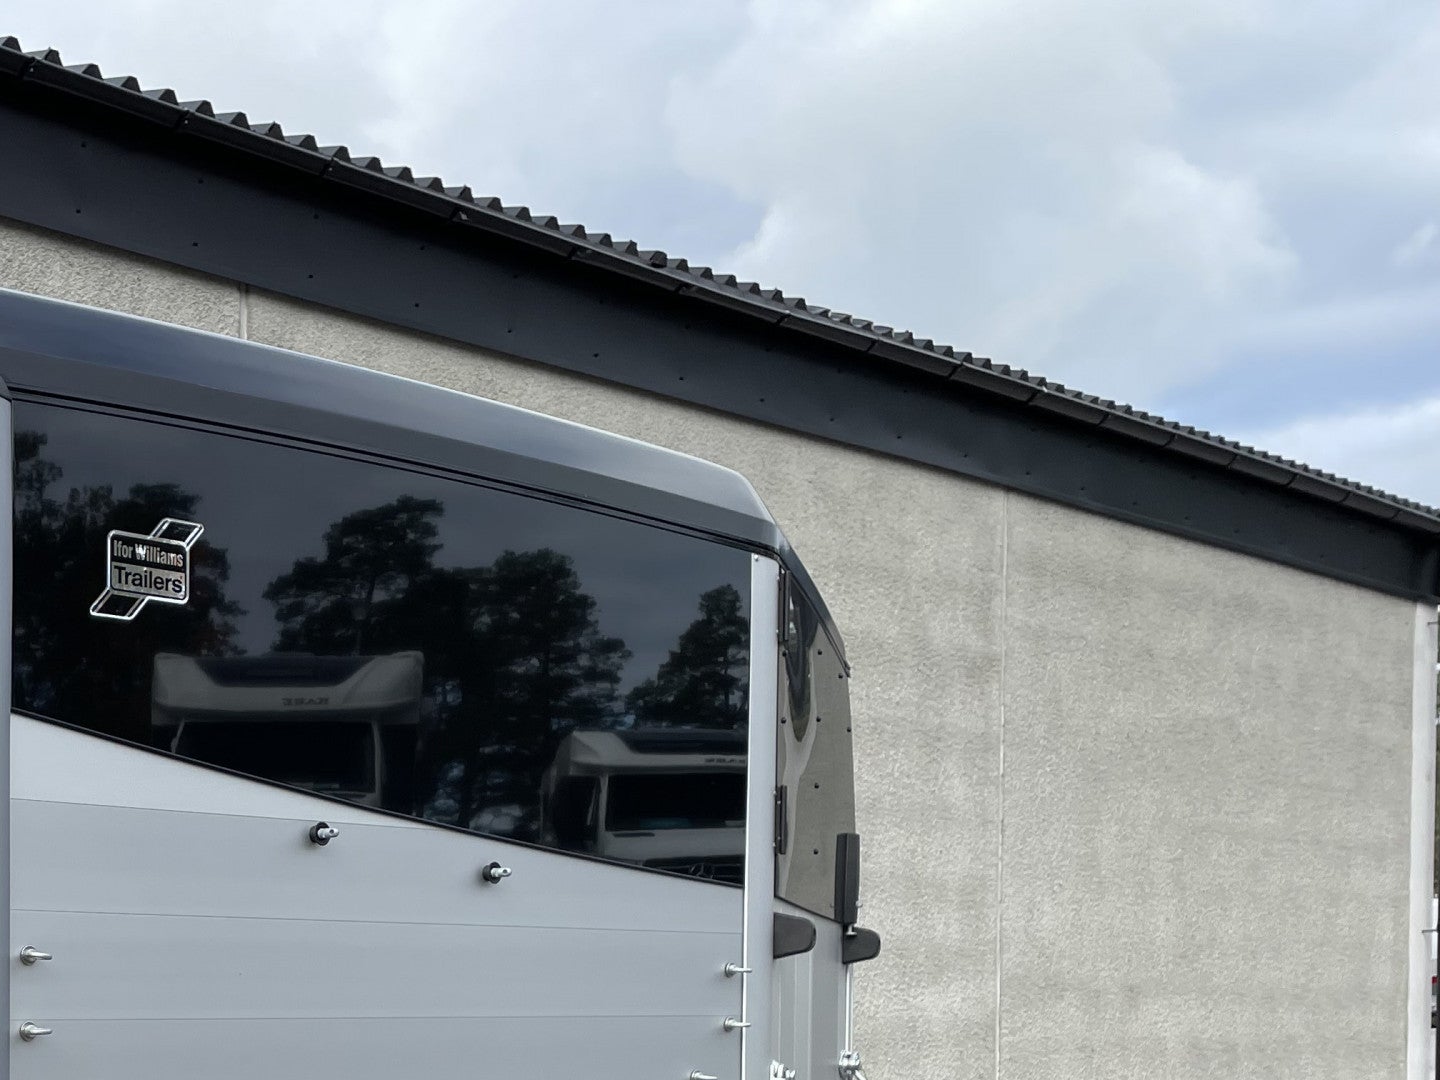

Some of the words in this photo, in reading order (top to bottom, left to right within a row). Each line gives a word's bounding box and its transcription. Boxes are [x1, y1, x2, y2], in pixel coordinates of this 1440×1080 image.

[113, 540, 133, 558] Ifor
[134, 543, 184, 567] Williams
[113, 565, 184, 593] Trailers
